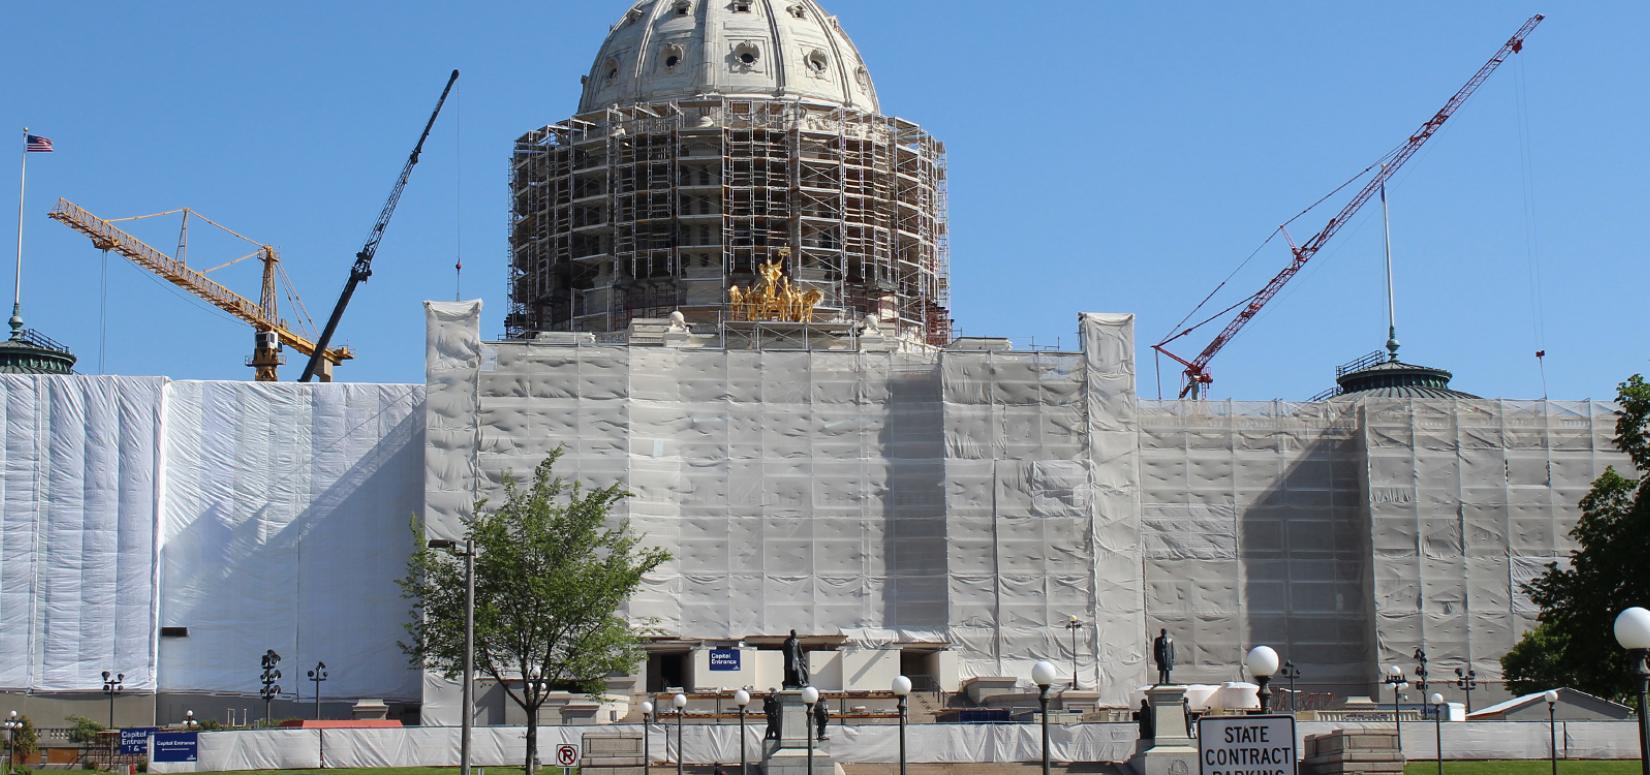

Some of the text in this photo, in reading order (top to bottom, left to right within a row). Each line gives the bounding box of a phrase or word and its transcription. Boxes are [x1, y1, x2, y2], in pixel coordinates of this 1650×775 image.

[121, 731, 147, 739] Capitol
[1224, 726, 1270, 743] STATE
[1205, 748, 1291, 765] CONTRACT
